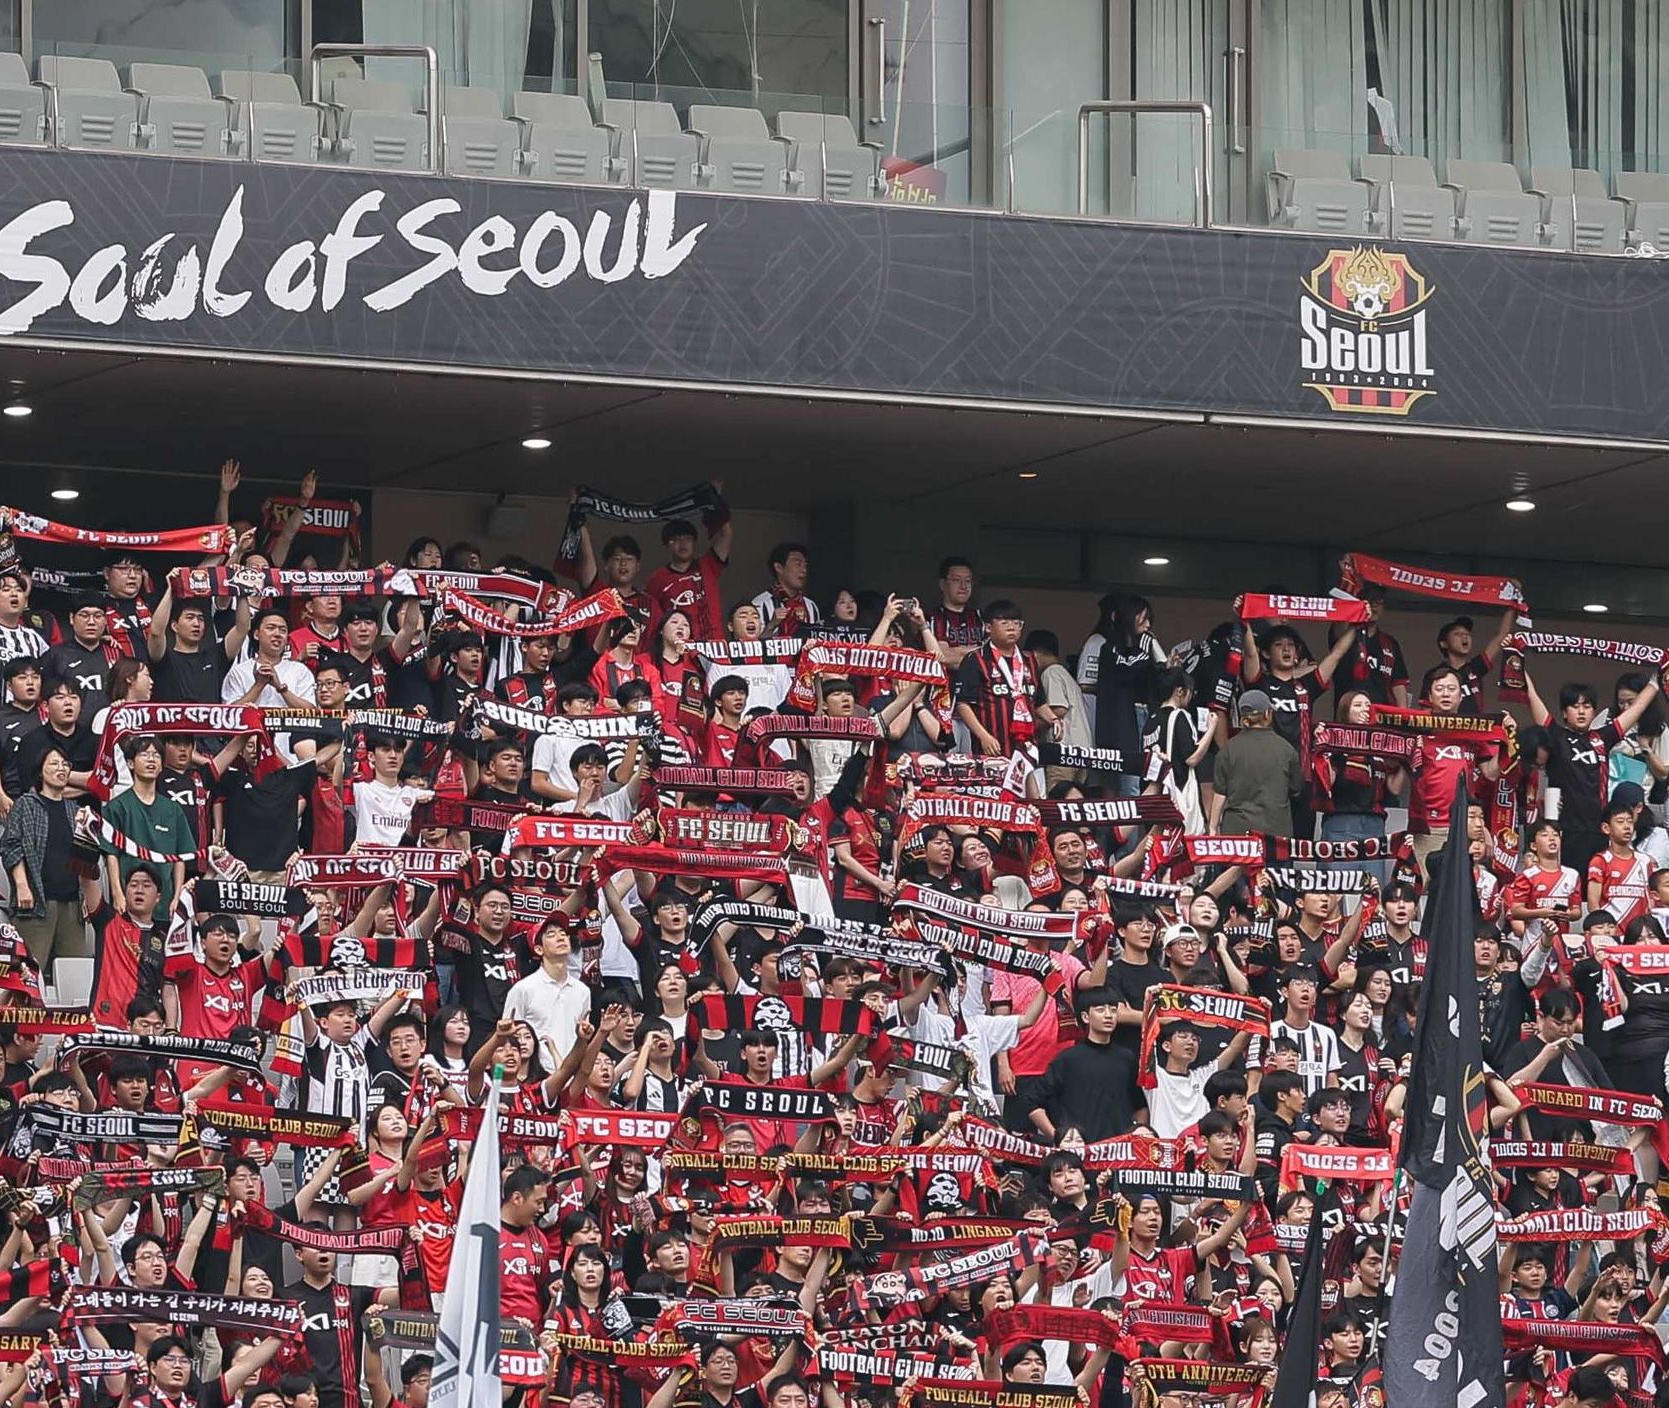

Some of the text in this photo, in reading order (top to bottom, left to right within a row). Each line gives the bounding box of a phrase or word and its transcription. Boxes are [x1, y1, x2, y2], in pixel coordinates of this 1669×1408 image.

[266, 190, 386, 313] of
[365, 190, 707, 312] Seoul
[1301, 294, 1435, 377] Seoul
[1359, 321, 1377, 331] FC
[485, 706, 637, 737] SUHO SHIN
[1060, 802, 1140, 822] FC SEOUL
[678, 819, 769, 843] FC SEOUL
[219, 883, 287, 904] FC SEOUL
[220, 901, 286, 914] SOUL SEOUL
[918, 889, 1045, 932] FOOTBALL CLUB SEOUL
[920, 924, 1048, 977] FOOTBALL CLUB SEOUL
[62, 1118, 135, 1136] FC SEOUL
[1529, 1143, 1546, 1157] FC
[1119, 1171, 1243, 1191] FOOTBALL CLUB SEOUL
[719, 1222, 777, 1237] FOOTBALL
[783, 1221, 810, 1236] CLUB
[912, 1225, 1015, 1242] NO.10 LINGARD
[72, 1293, 299, 1324] 그대들이 가는 길 우리가 지켜주리라
[925, 1387, 991, 1406] FOOTBALL
[997, 1391, 1032, 1408] CLUB
